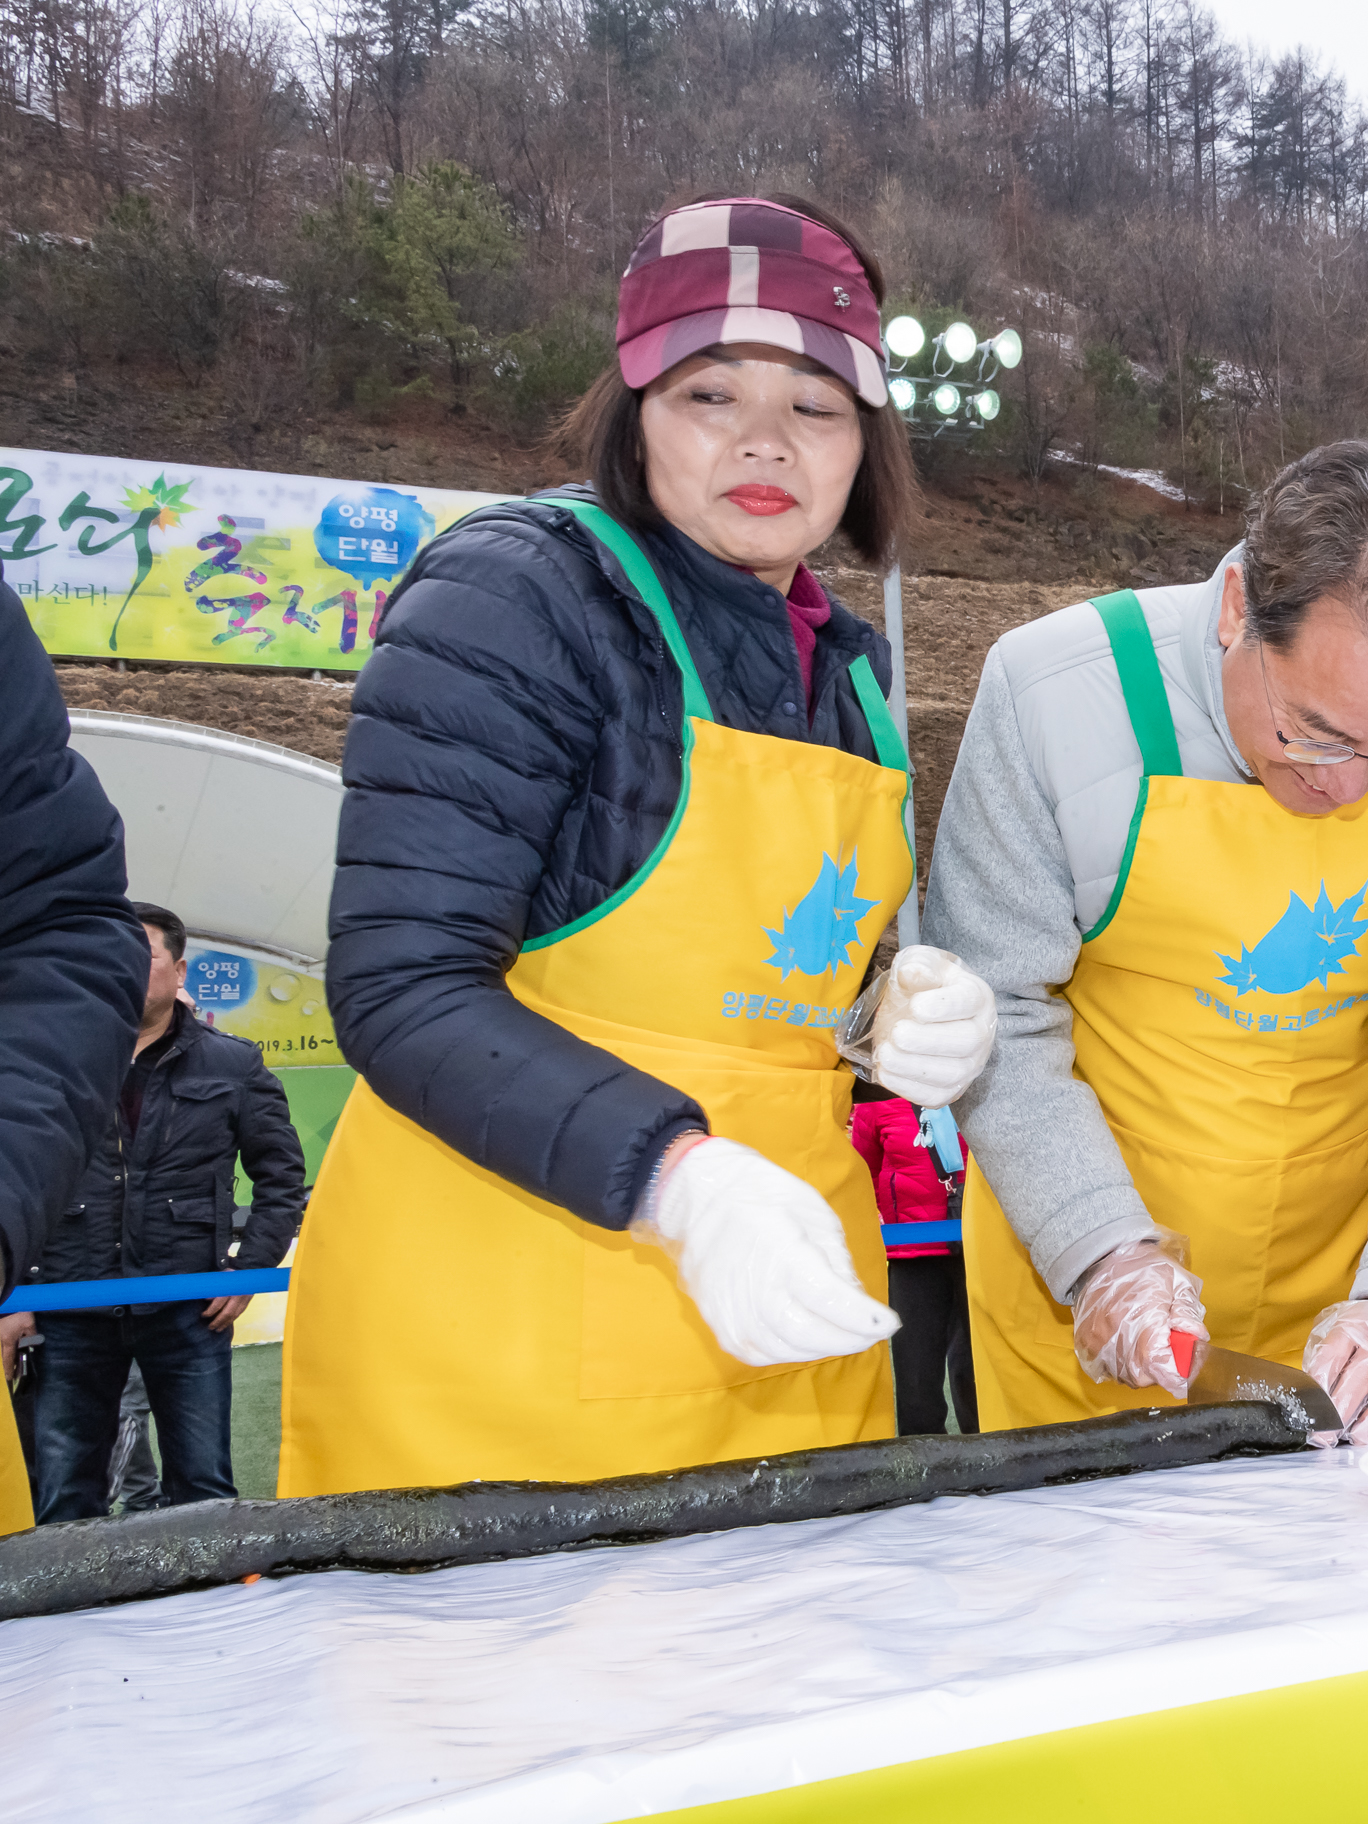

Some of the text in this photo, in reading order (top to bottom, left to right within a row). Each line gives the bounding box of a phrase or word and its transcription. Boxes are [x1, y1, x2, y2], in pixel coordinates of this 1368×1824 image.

[338, 504, 399, 532] 양평
[338, 536, 399, 565] 단월
[16, 579, 108, 607] 마신다!
[198, 961, 240, 980] 양평
[198, 983, 240, 1000] 단월
[257, 1035, 334, 1052] 019.3.16~
